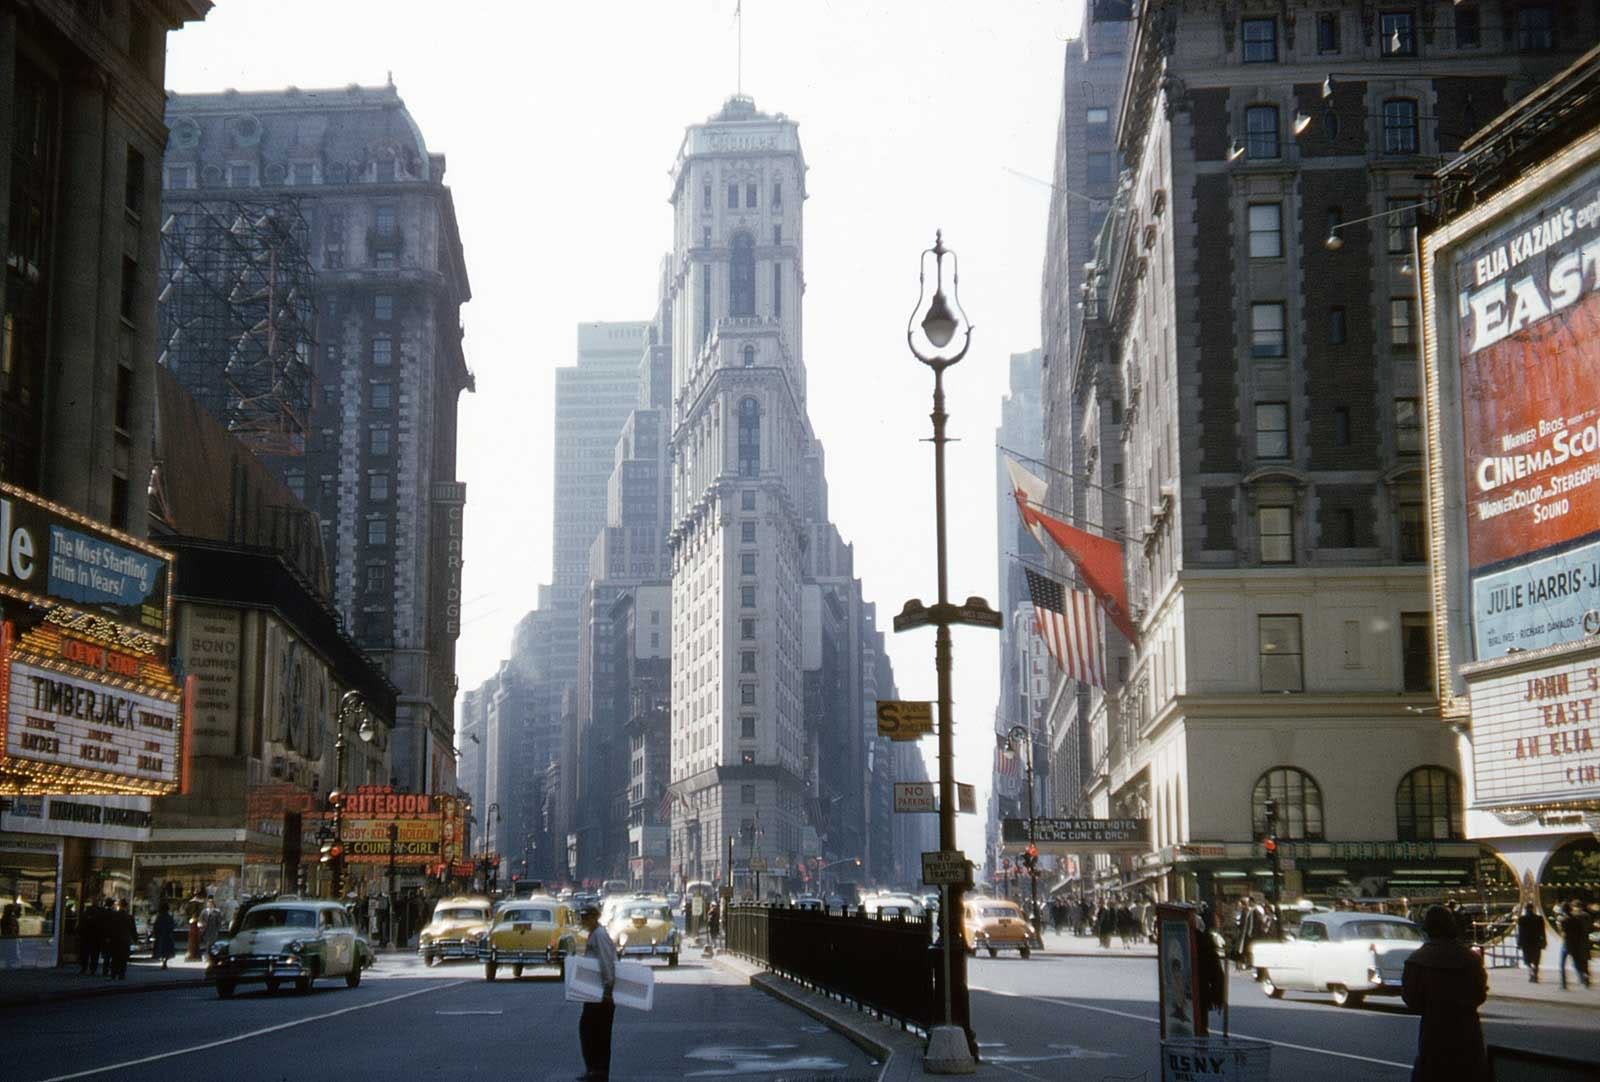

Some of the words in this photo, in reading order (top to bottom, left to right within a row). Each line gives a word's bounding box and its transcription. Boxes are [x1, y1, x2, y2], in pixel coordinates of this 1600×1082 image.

[1475, 246, 1510, 286] ELIA
[1510, 207, 1575, 267] KAZAN'S
[1533, 498, 1569, 523] SOUND
[53, 531, 72, 557] The
[75, 538, 101, 566] Most
[103, 548, 148, 590] Startling
[446, 507, 460, 635] CLARIDGE
[52, 556, 75, 582] Film
[77, 564, 89, 587] In
[90, 568, 126, 597] Years!
[1487, 584, 1523, 615] JULIE
[1528, 568, 1582, 606] HARRIS
[191, 639, 236, 654] BOND
[1524, 673, 1569, 702] JOHN
[27, 675, 140, 731] TIMBERJACK
[879, 704, 900, 732] S
[20, 732, 60, 755] HAYDEN
[80, 743, 119, 765] MENJOU
[1515, 735, 1540, 760] AN
[1550, 728, 1593, 757] ELIA
[897, 798, 930, 806] PARKING
[904, 786, 924, 796] NO
[1074, 821, 1104, 830] ASTOR
[408, 842, 435, 854] GIRL
